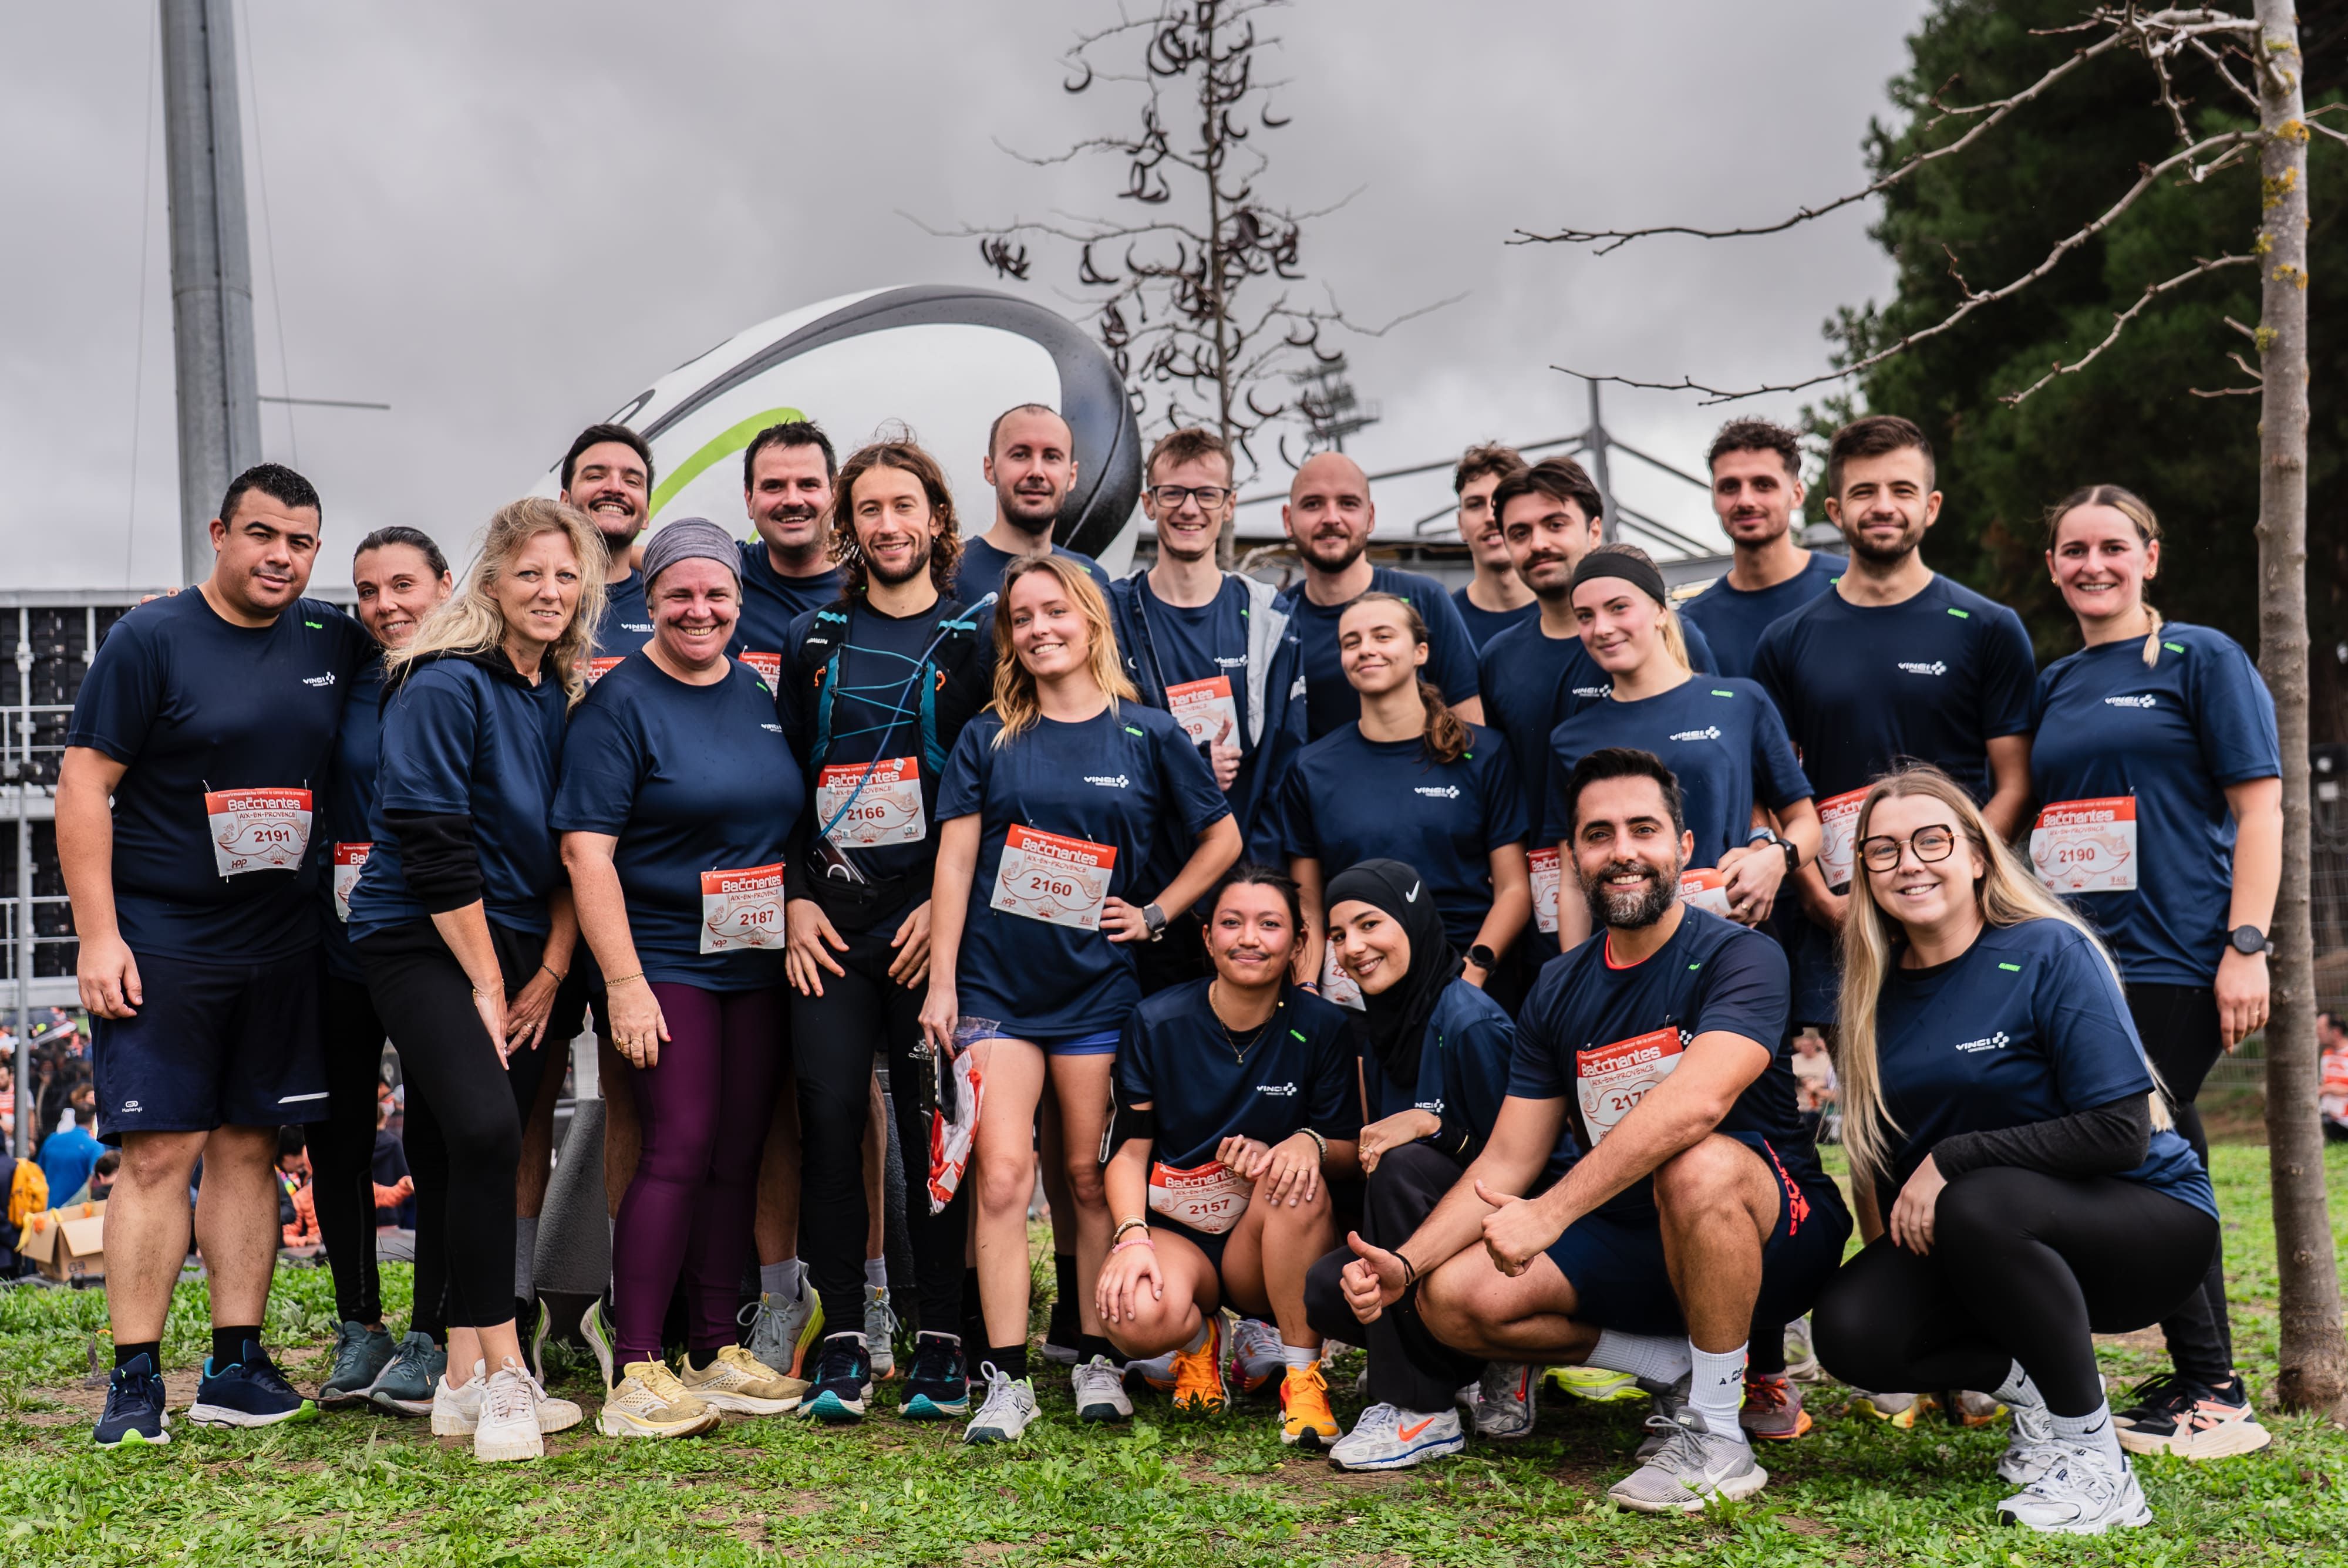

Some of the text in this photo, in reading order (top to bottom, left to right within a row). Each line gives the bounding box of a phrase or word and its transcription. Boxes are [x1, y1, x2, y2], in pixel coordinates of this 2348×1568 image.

[2104, 696, 2139, 704] VINCI
[1184, 723, 1202, 736] 69
[1669, 730, 1704, 740] VINCI
[227, 797, 301, 811] Bacchantes
[847, 806, 885, 821] 2166
[2043, 810, 2115, 827] Bacchantes
[254, 830, 289, 842] 2191
[1021, 838, 1098, 866] Bacchantes
[2059, 848, 2095, 863] 2190
[722, 875, 781, 893] Bacchantes
[1030, 876, 1072, 896] 2160
[740, 910, 774, 926] 2187
[1955, 1037, 1991, 1051] VINCI
[1581, 1046, 1661, 1077] Bacchantes
[1592, 1064, 1654, 1086] AIX-EN-PROVENCE
[1165, 1168, 1234, 1188] Bacchante
[1189, 1199, 1230, 1215] 2157
